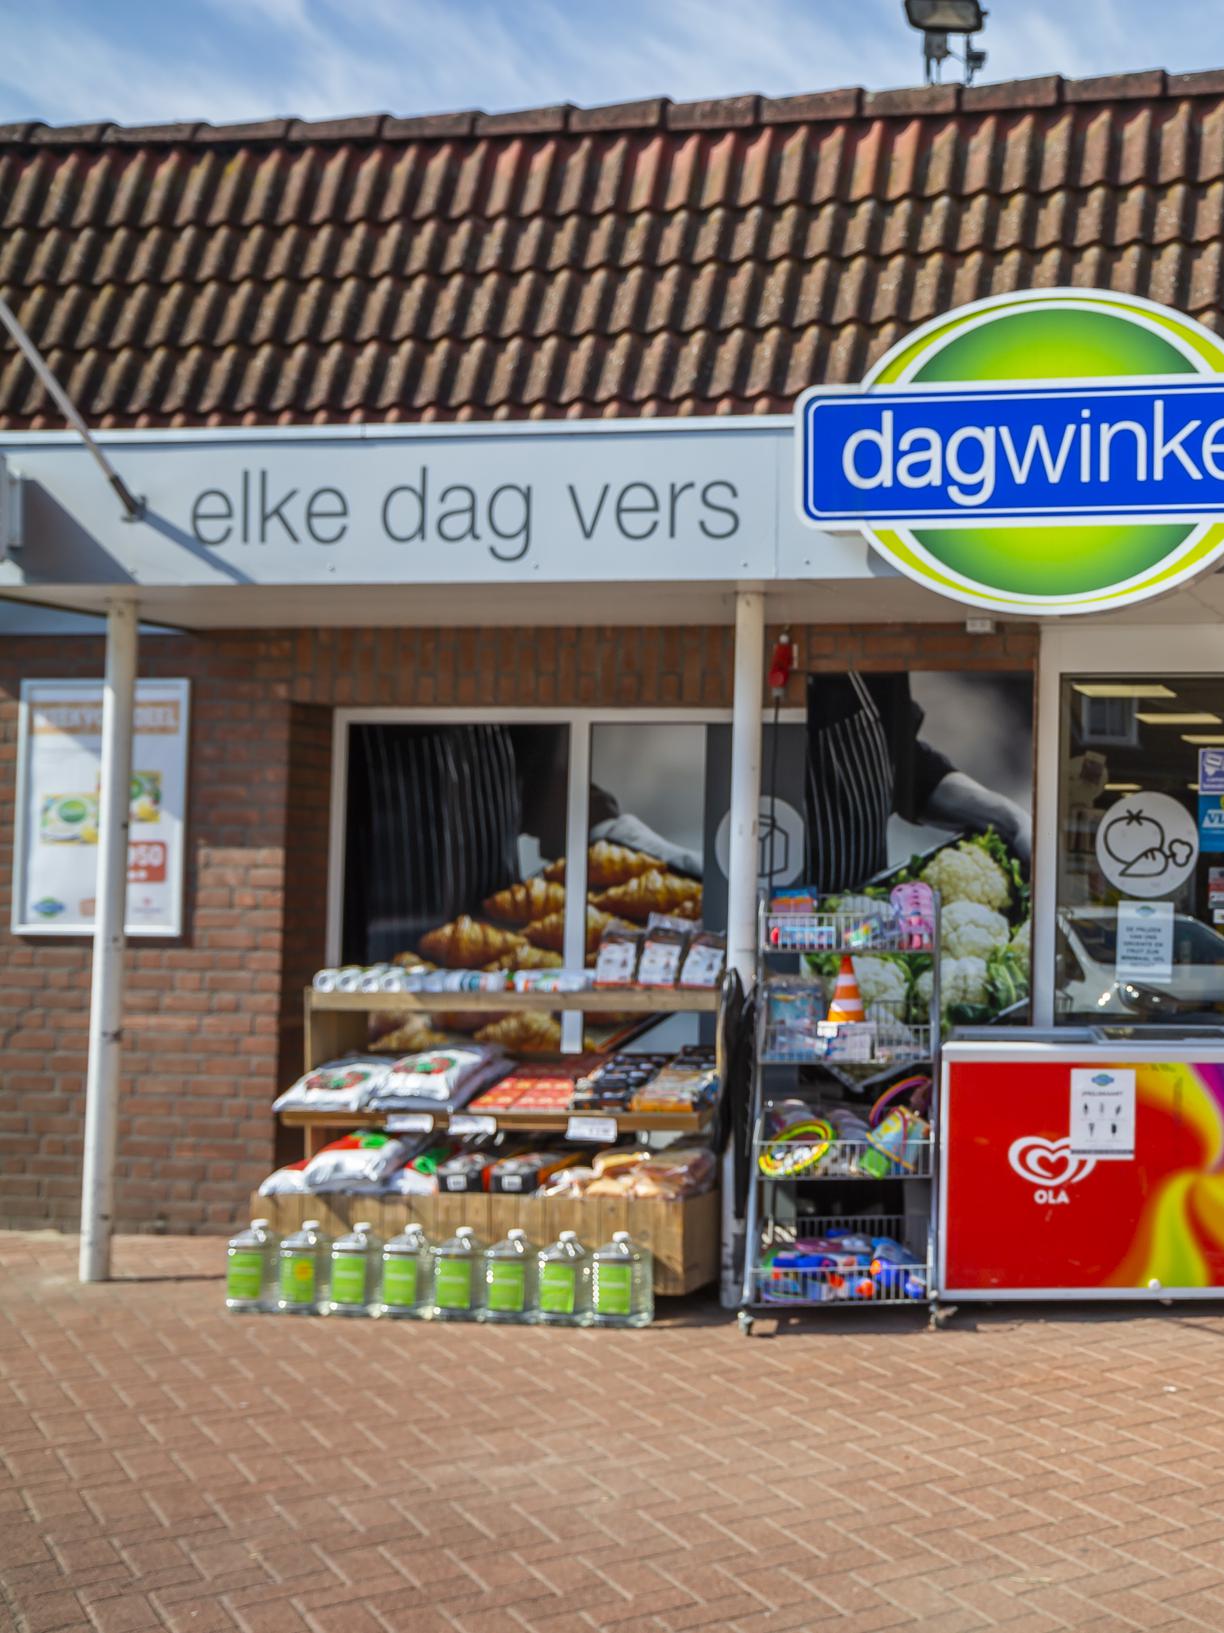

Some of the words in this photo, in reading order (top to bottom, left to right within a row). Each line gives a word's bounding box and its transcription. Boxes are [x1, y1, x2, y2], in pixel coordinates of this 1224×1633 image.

[191, 469, 349, 546] elke
[382, 466, 532, 562] dag
[568, 480, 741, 539] vers
[1034, 1189, 1070, 1205] OLA
